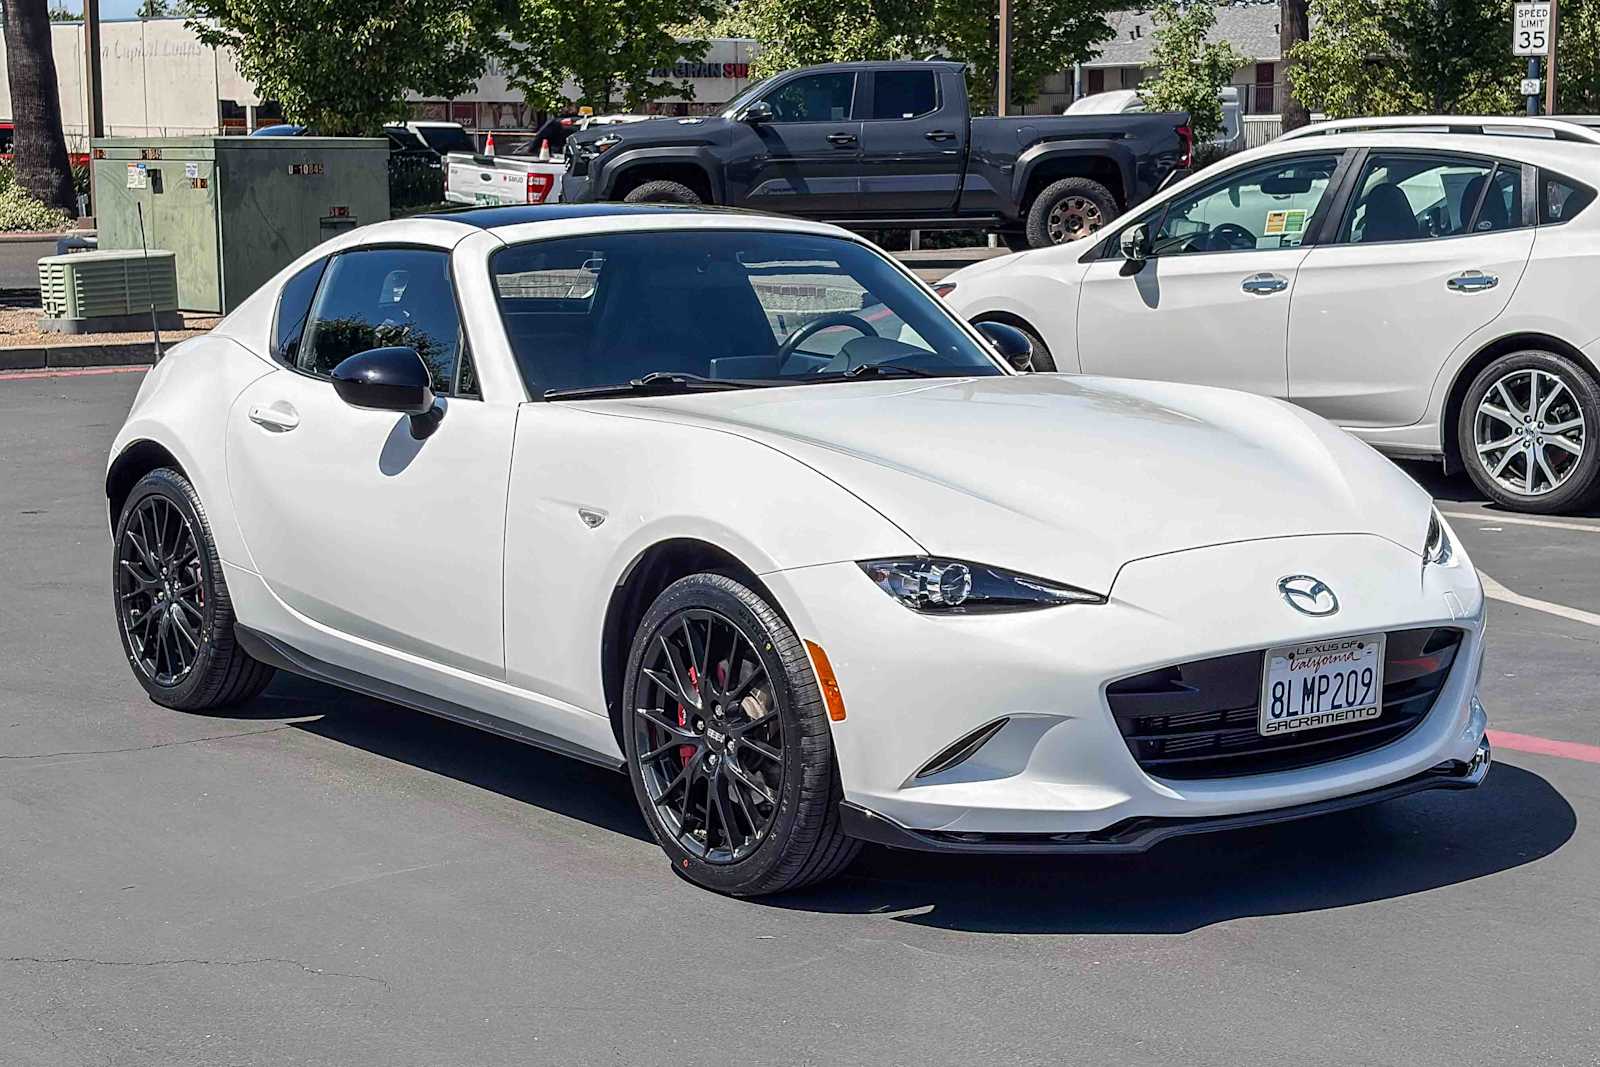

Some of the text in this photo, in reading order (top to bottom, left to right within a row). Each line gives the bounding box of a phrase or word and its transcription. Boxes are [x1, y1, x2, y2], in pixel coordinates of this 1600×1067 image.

[1518, 9, 1548, 18] SPEED
[1521, 20, 1544, 28] LIMIT
[1519, 31, 1545, 49] 35
[1296, 640, 1358, 655] LEXUS OF
[1289, 651, 1361, 673] California
[1271, 667, 1373, 719] 8LMP209
[1265, 707, 1377, 733] SACRAMENTO
